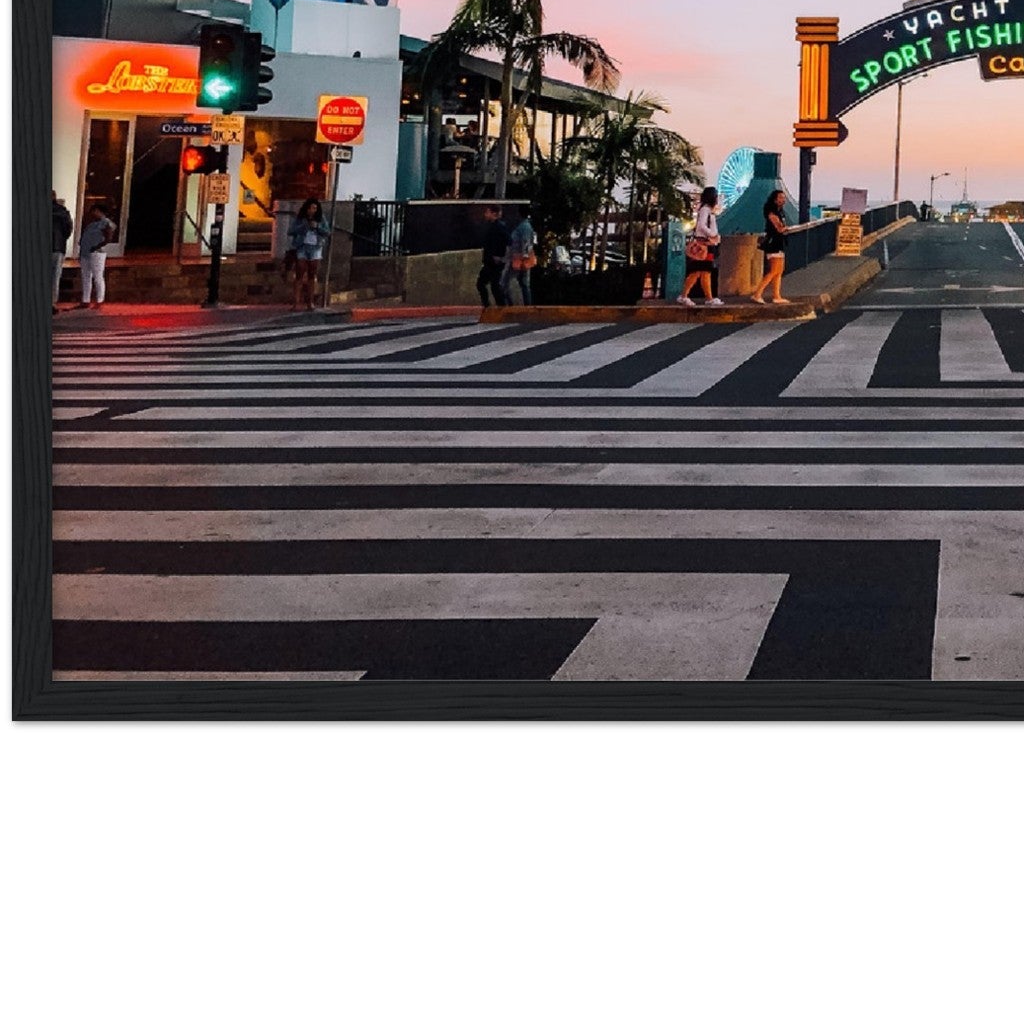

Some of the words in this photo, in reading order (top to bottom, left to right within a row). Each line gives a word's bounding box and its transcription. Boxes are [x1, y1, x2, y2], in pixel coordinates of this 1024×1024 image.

[143, 64, 169, 76] THE
[850, 37, 933, 93] SPORT
[326, 106, 339, 114] DO
[342, 106, 360, 115] NOT
[162, 123, 198, 133] Ocean
[327, 126, 355, 135] ENTER
